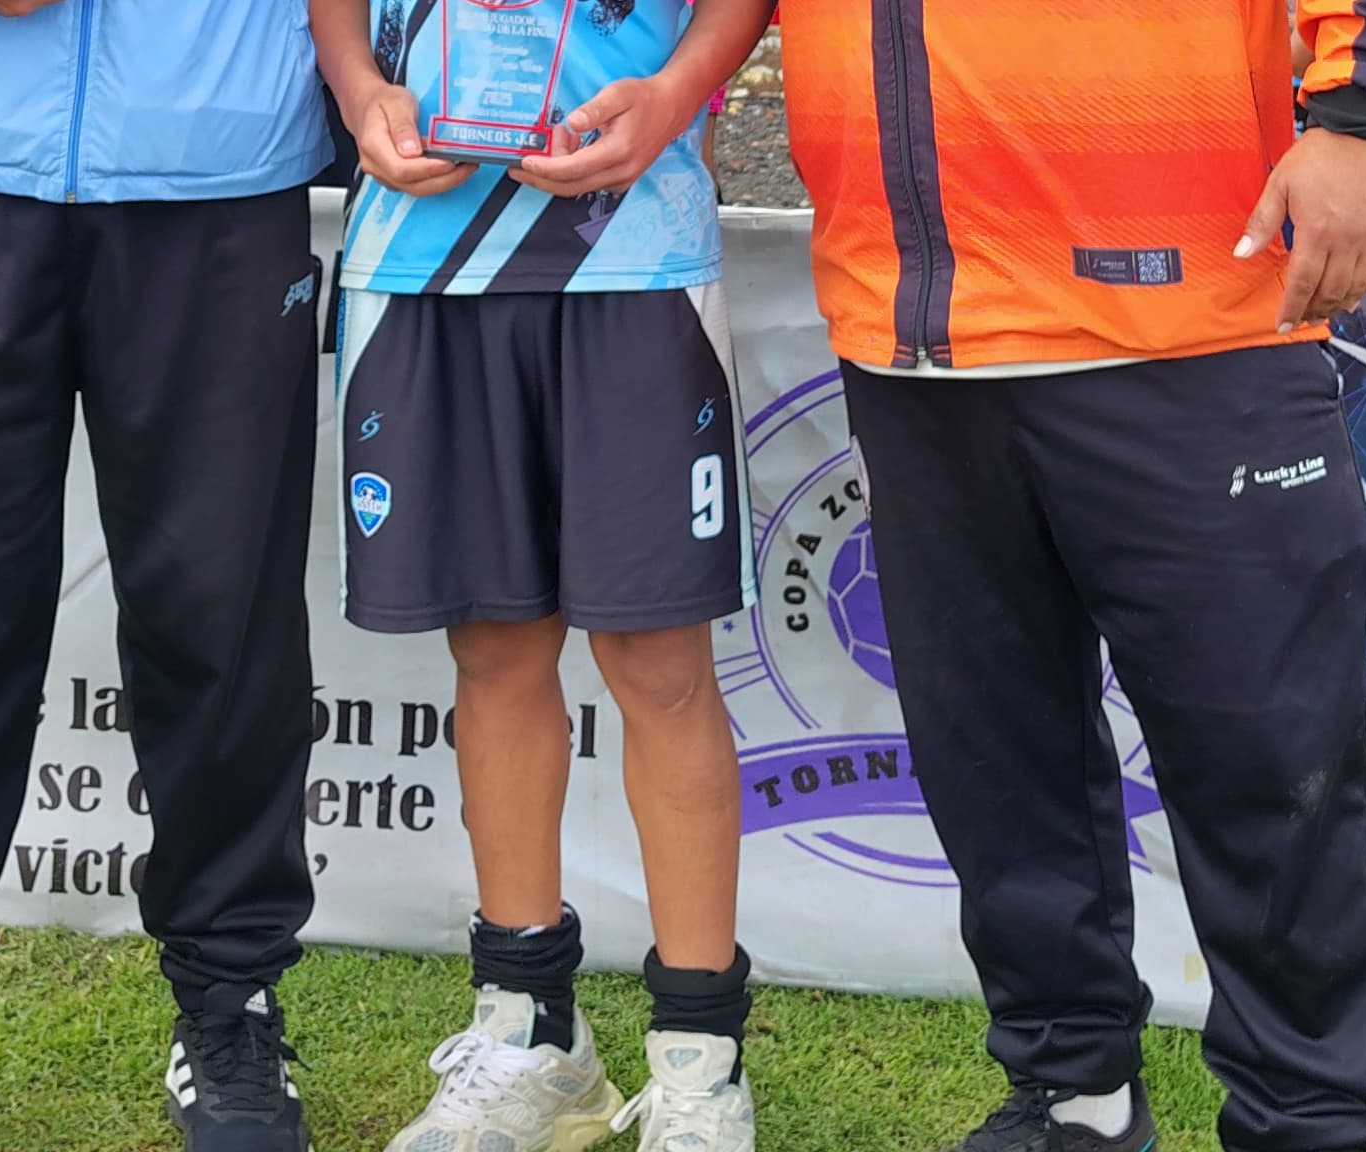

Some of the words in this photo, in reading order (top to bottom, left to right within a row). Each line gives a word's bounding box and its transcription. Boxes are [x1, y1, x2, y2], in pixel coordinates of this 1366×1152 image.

[450, 126, 511, 145] TORNEOS
[691, 454, 724, 540] 9
[1254, 465, 1297, 484] Lucky
[1299, 456, 1325, 474] Line
[783, 532, 823, 633] COPA
[37, 761, 103, 813] se
[753, 749, 919, 809] TORN
